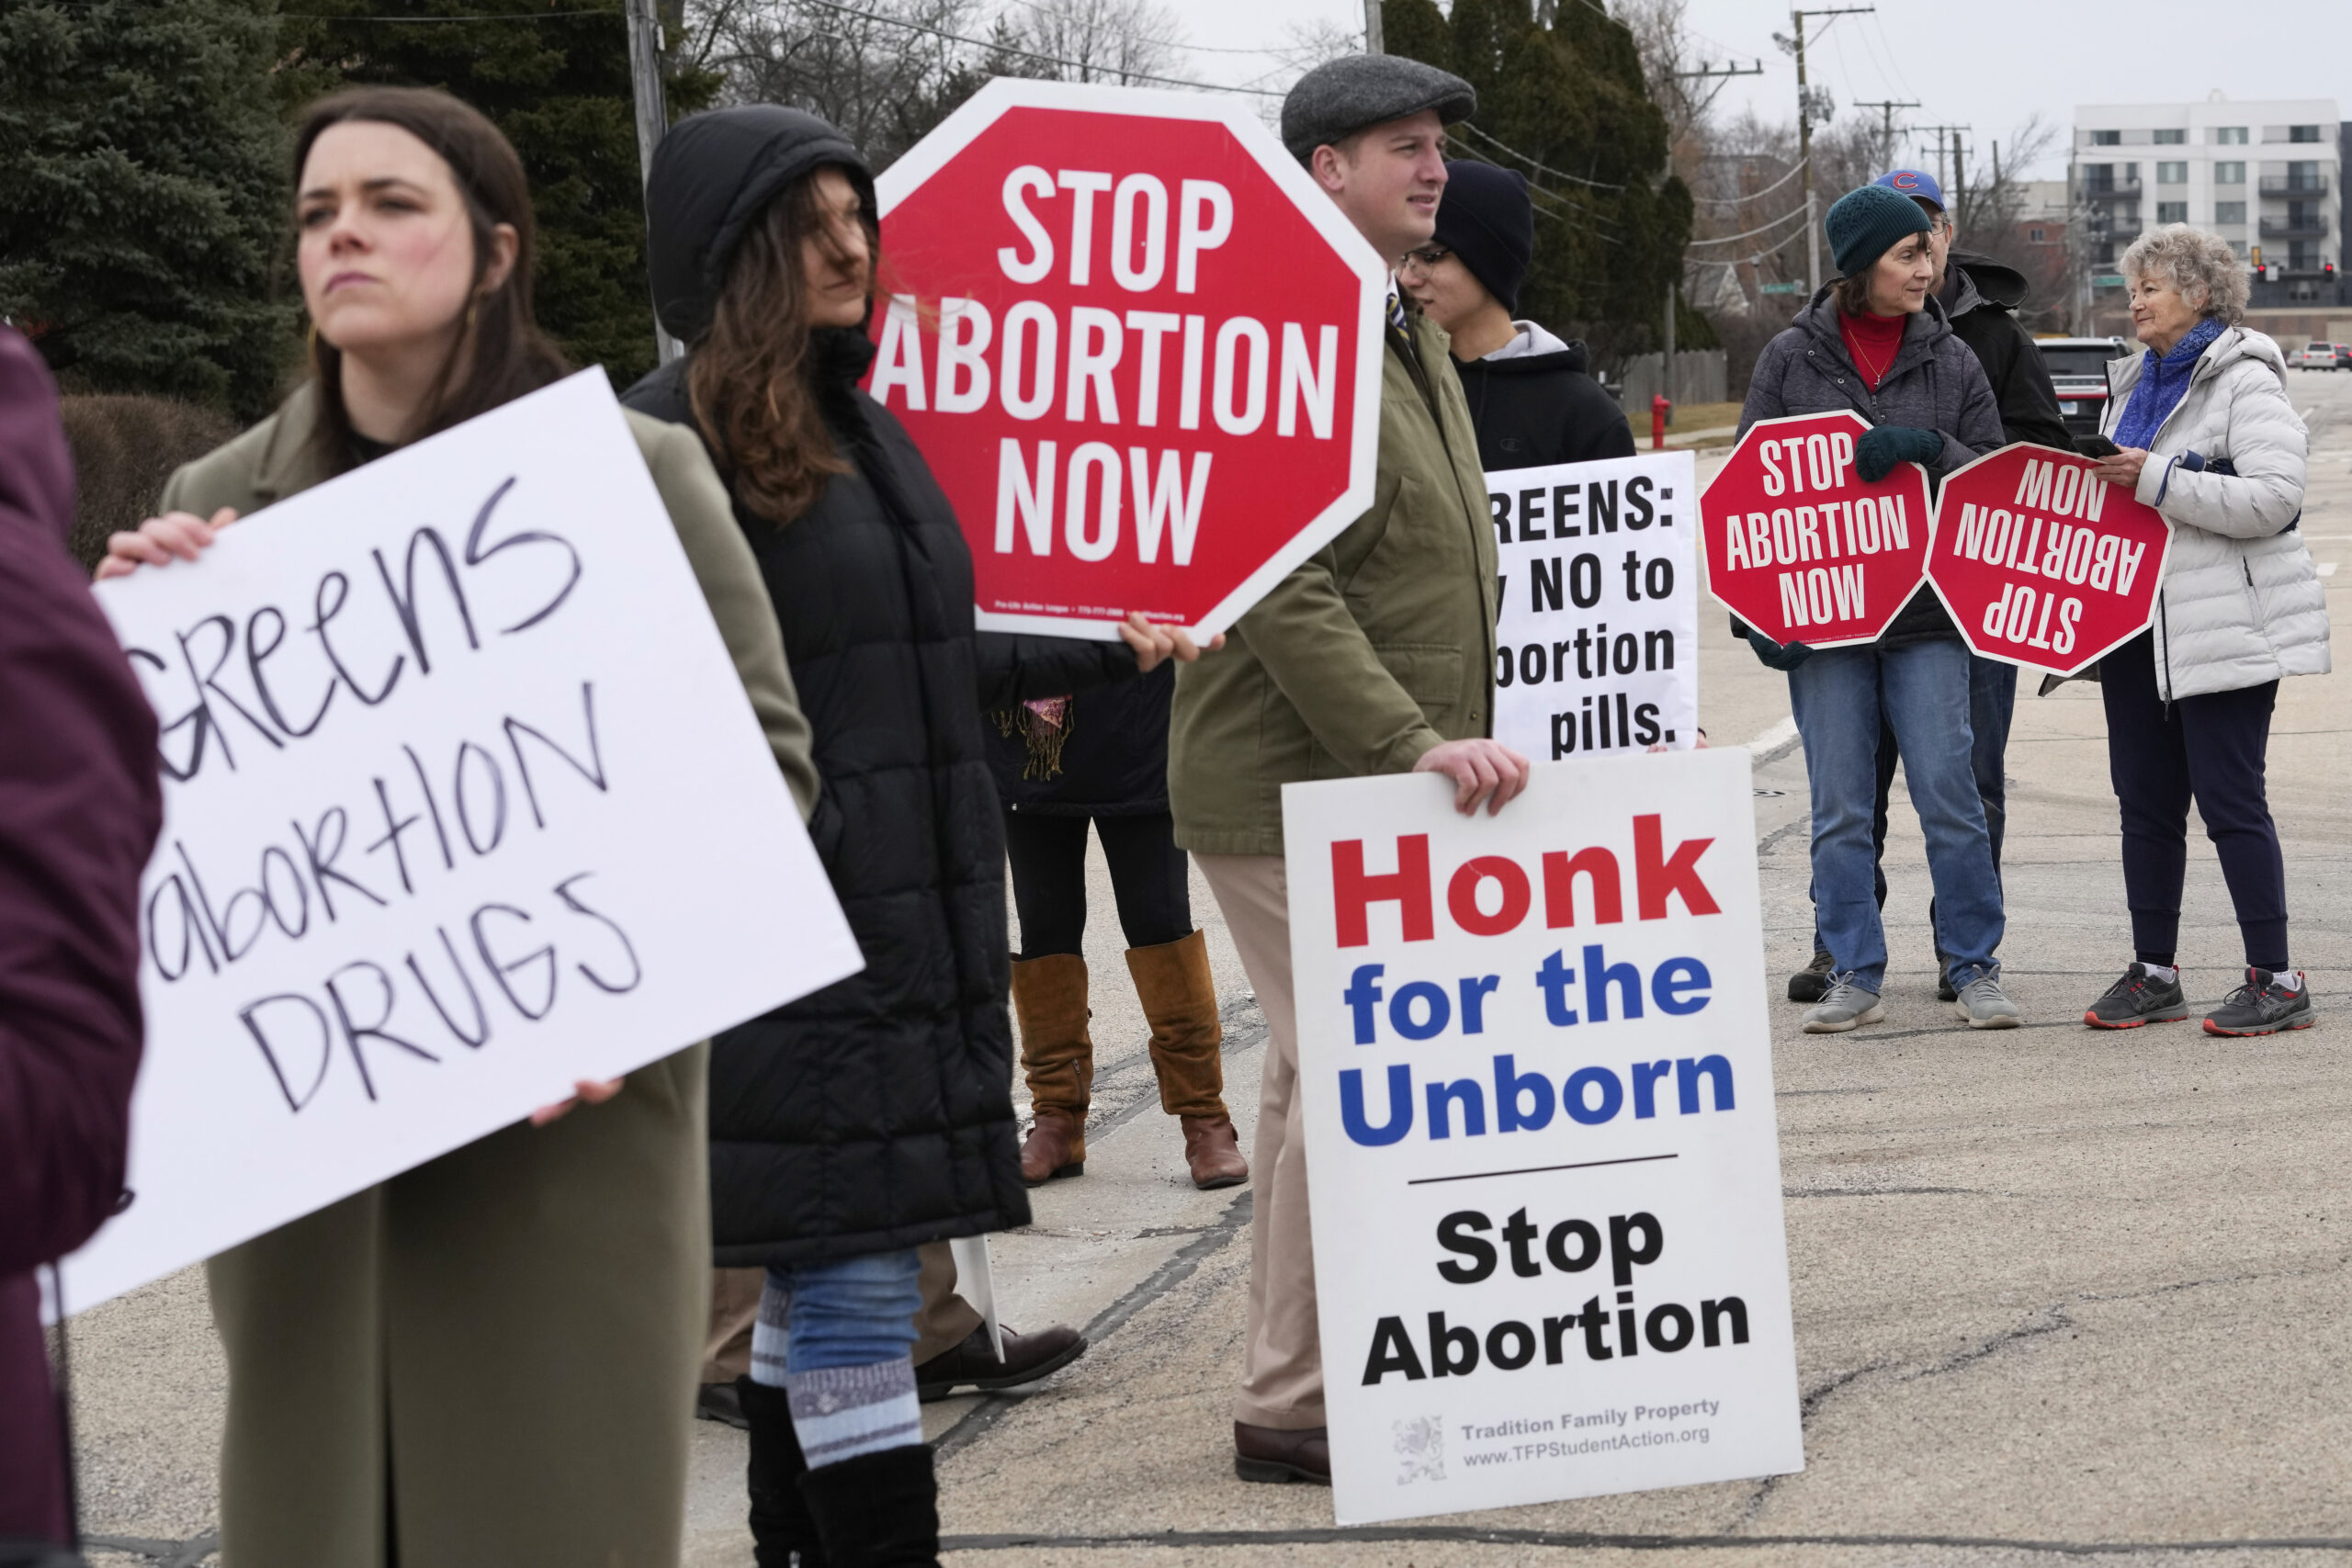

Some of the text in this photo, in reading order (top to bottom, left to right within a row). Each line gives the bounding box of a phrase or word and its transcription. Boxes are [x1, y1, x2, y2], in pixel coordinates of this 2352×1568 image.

[997, 164, 1234, 294] STOP
[869, 293, 1339, 440] ABORTION
[994, 437, 1214, 567] NOW
[1759, 432, 1854, 497] STOP
[2014, 458, 2109, 523] NOW
[1725, 494, 1910, 571] ABORTION
[1953, 502, 2146, 596] ABORTION
[1531, 553, 1601, 613] NO
[1623, 550, 1674, 602] to
[1778, 563, 1865, 628] NOW
[1982, 582, 2084, 655] STOP
[1551, 693, 1676, 761] pills.
[1330, 813, 1723, 949] Honk
[239, 871, 641, 1114] DRUGS
[1344, 943, 1713, 1045] for the
[1339, 1053, 1736, 1148] Unborn
[1435, 1206, 1665, 1286] Stop
[1361, 1291, 1751, 1387] Abortion
[1461, 1398, 1721, 1441] Tradition Family Property
[1464, 1427, 1711, 1468] www.TFPStudentAction.org
